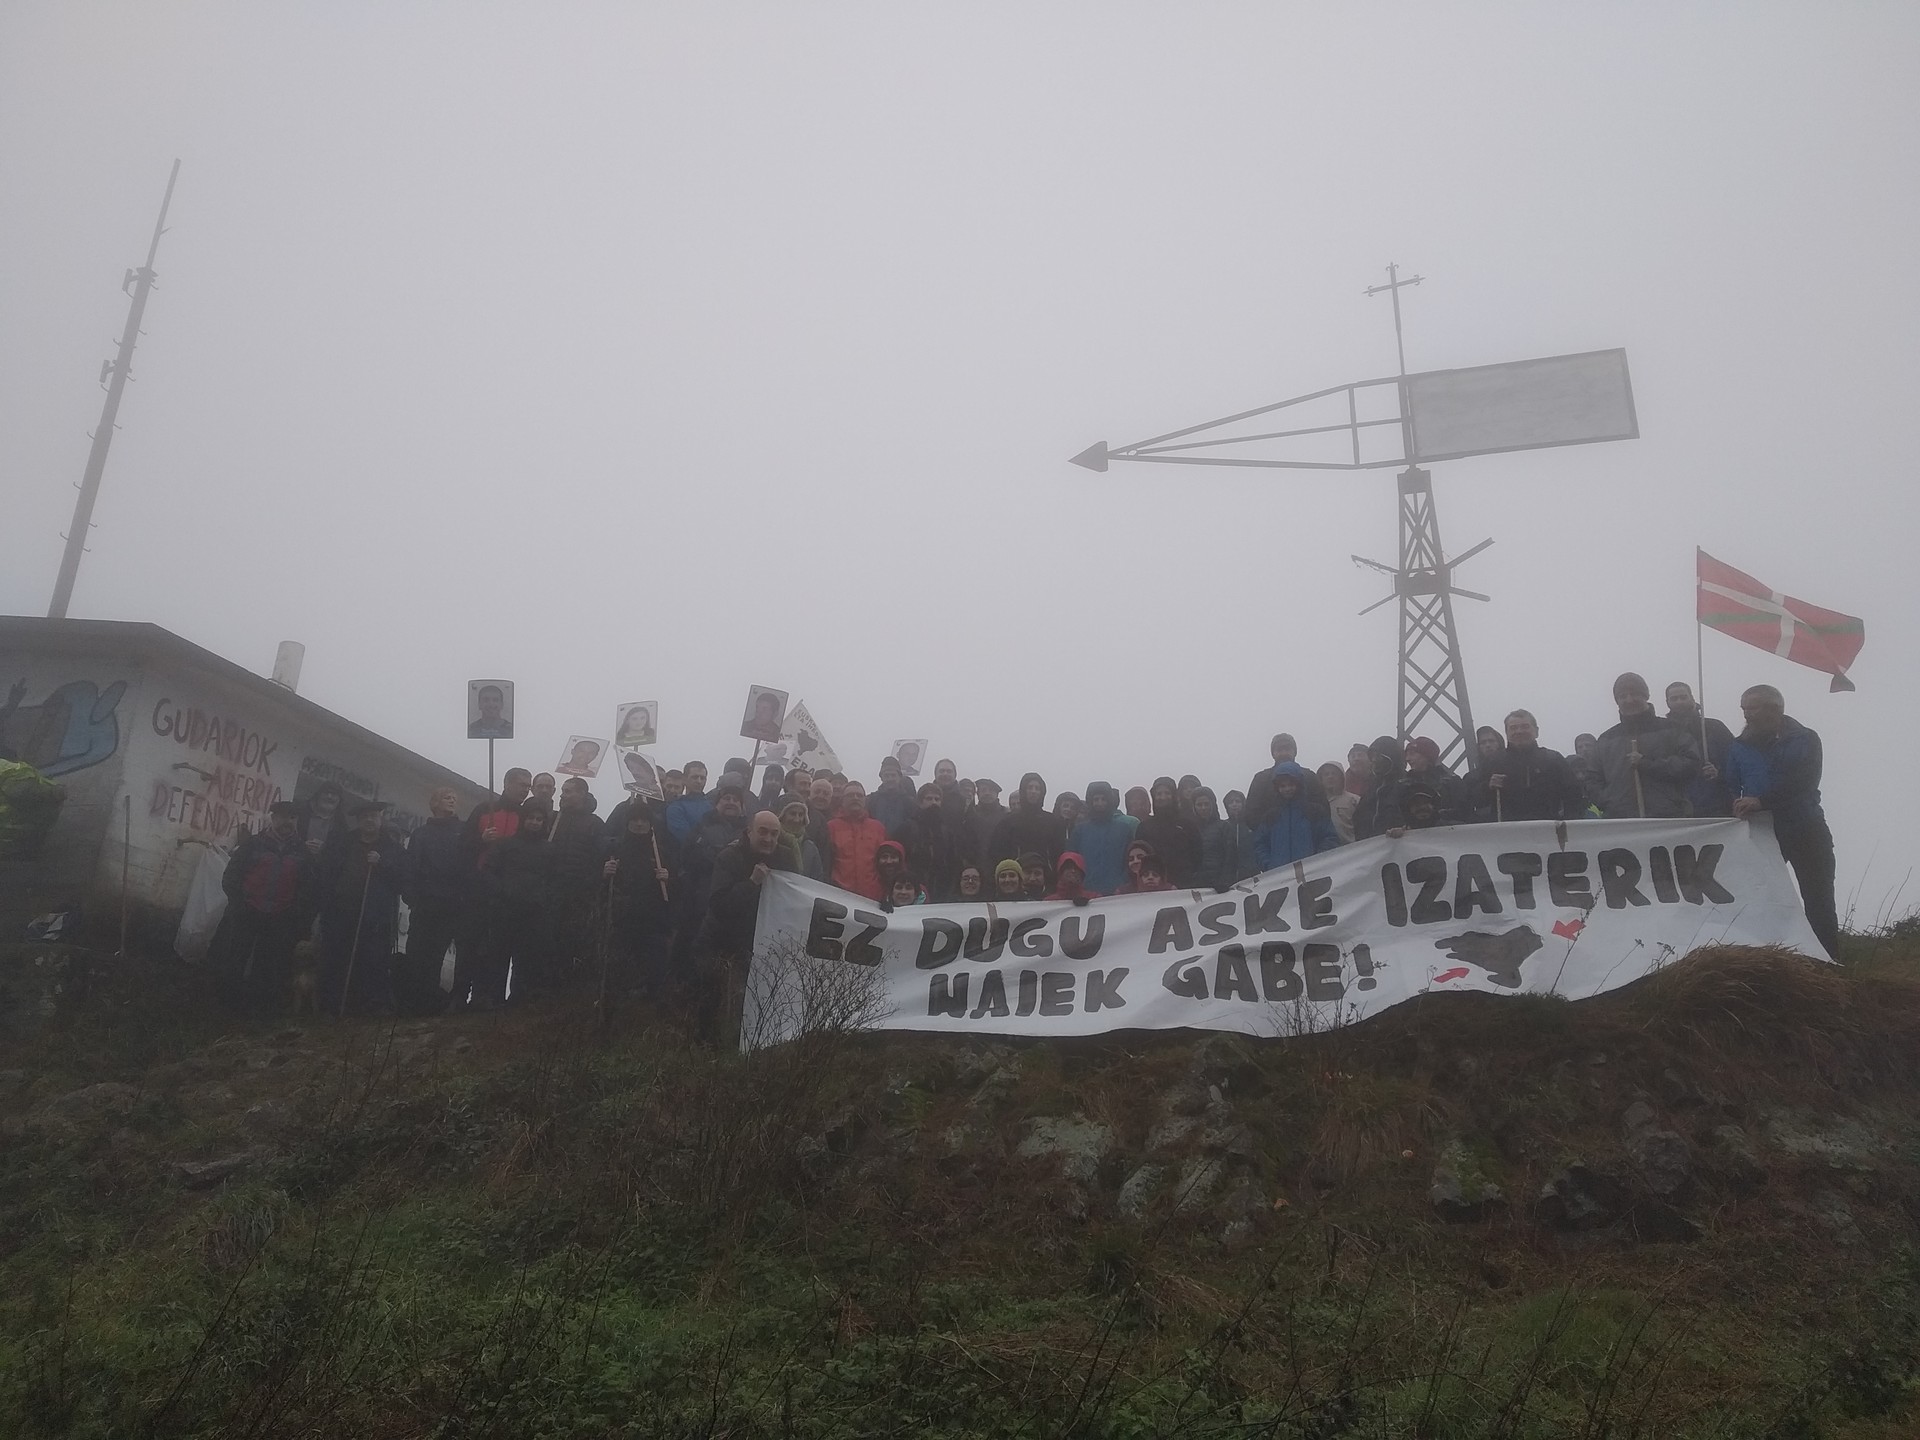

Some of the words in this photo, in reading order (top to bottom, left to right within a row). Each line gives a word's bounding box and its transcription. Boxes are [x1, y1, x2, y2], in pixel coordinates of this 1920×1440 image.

[152, 697, 278, 776] GUDARIOK
[806, 897, 888, 967] EZ
[915, 914, 1106, 970] DUGU
[1147, 876, 1338, 954] ASKE
[1381, 843, 1735, 927] IZATERIK
[1161, 941, 1377, 1003] GABE!
